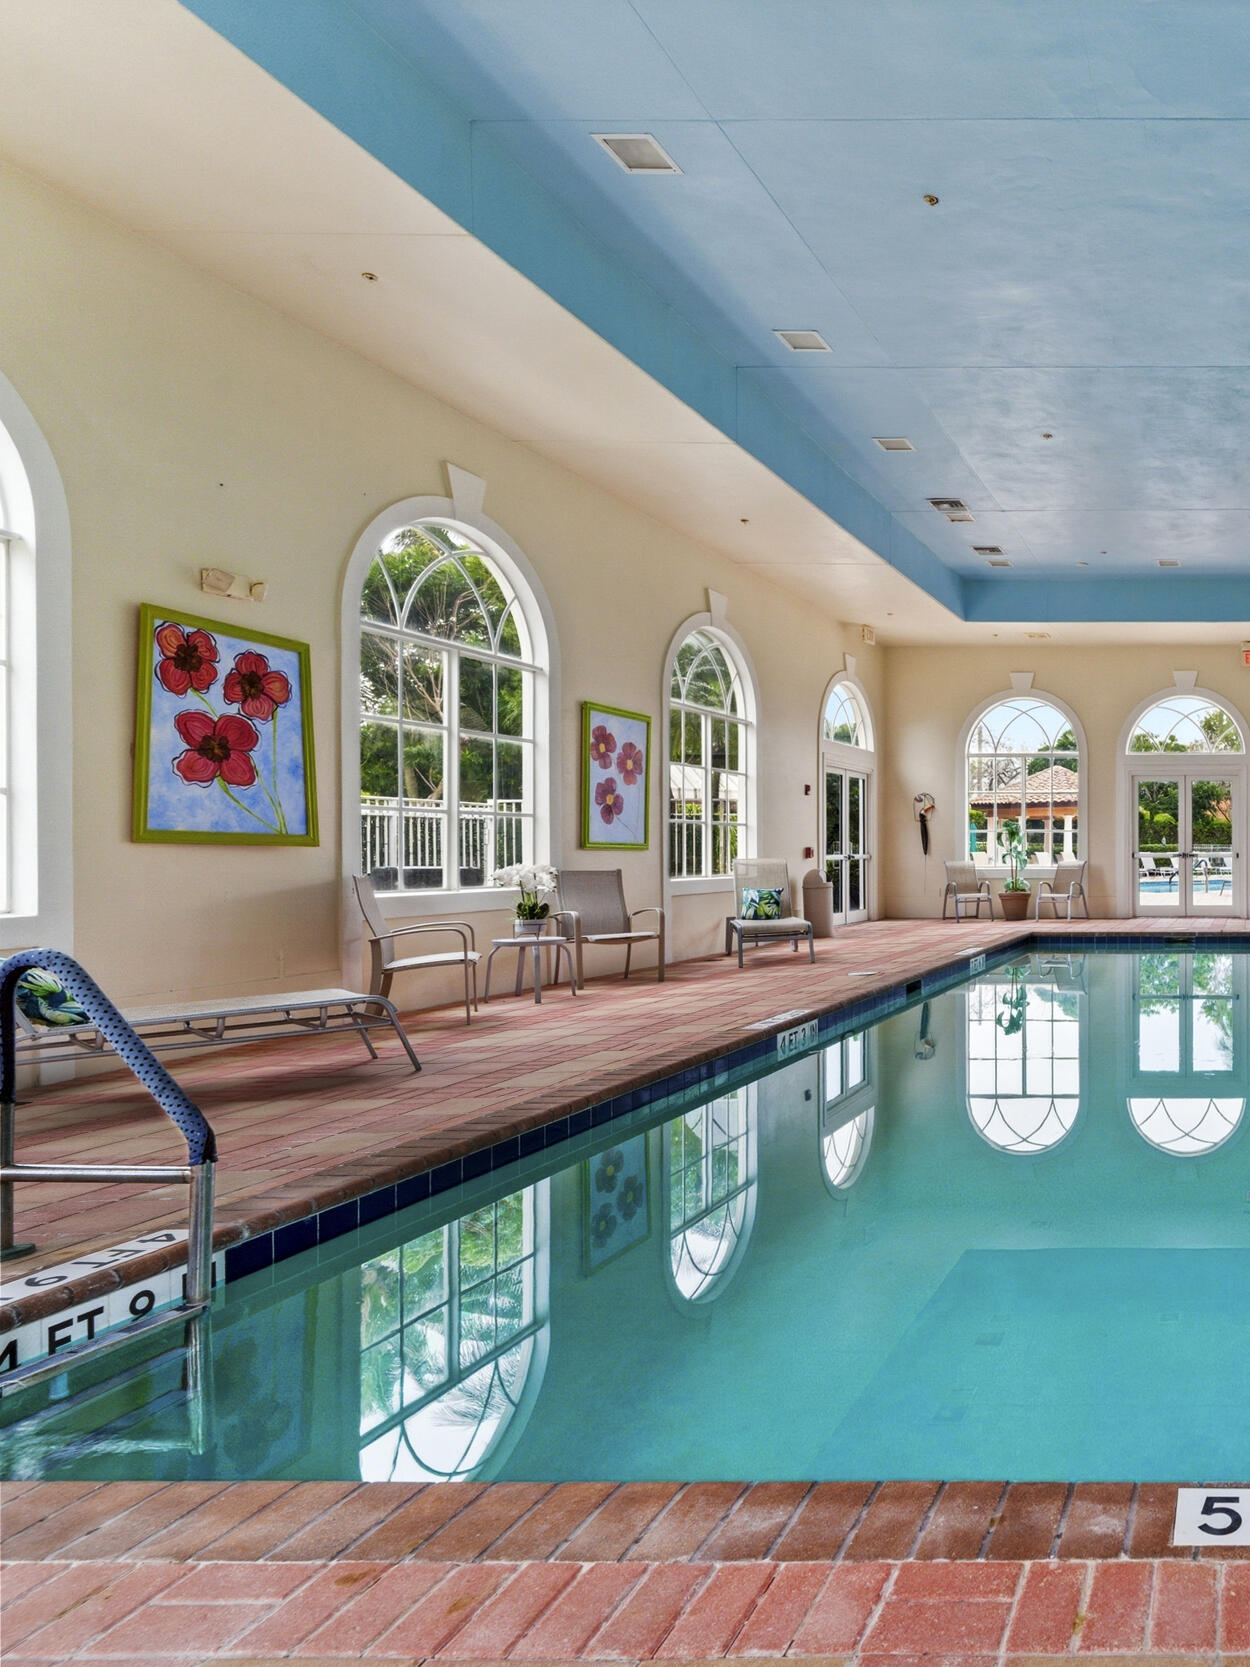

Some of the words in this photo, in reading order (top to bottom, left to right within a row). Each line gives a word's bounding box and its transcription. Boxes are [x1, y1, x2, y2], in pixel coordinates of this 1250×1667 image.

[137, 1233, 176, 1243] 4
[71, 1249, 150, 1269] FT
[48, 1306, 104, 1356] FT
[129, 1289, 155, 1322] 9
[1197, 1496, 1242, 1536] 5
